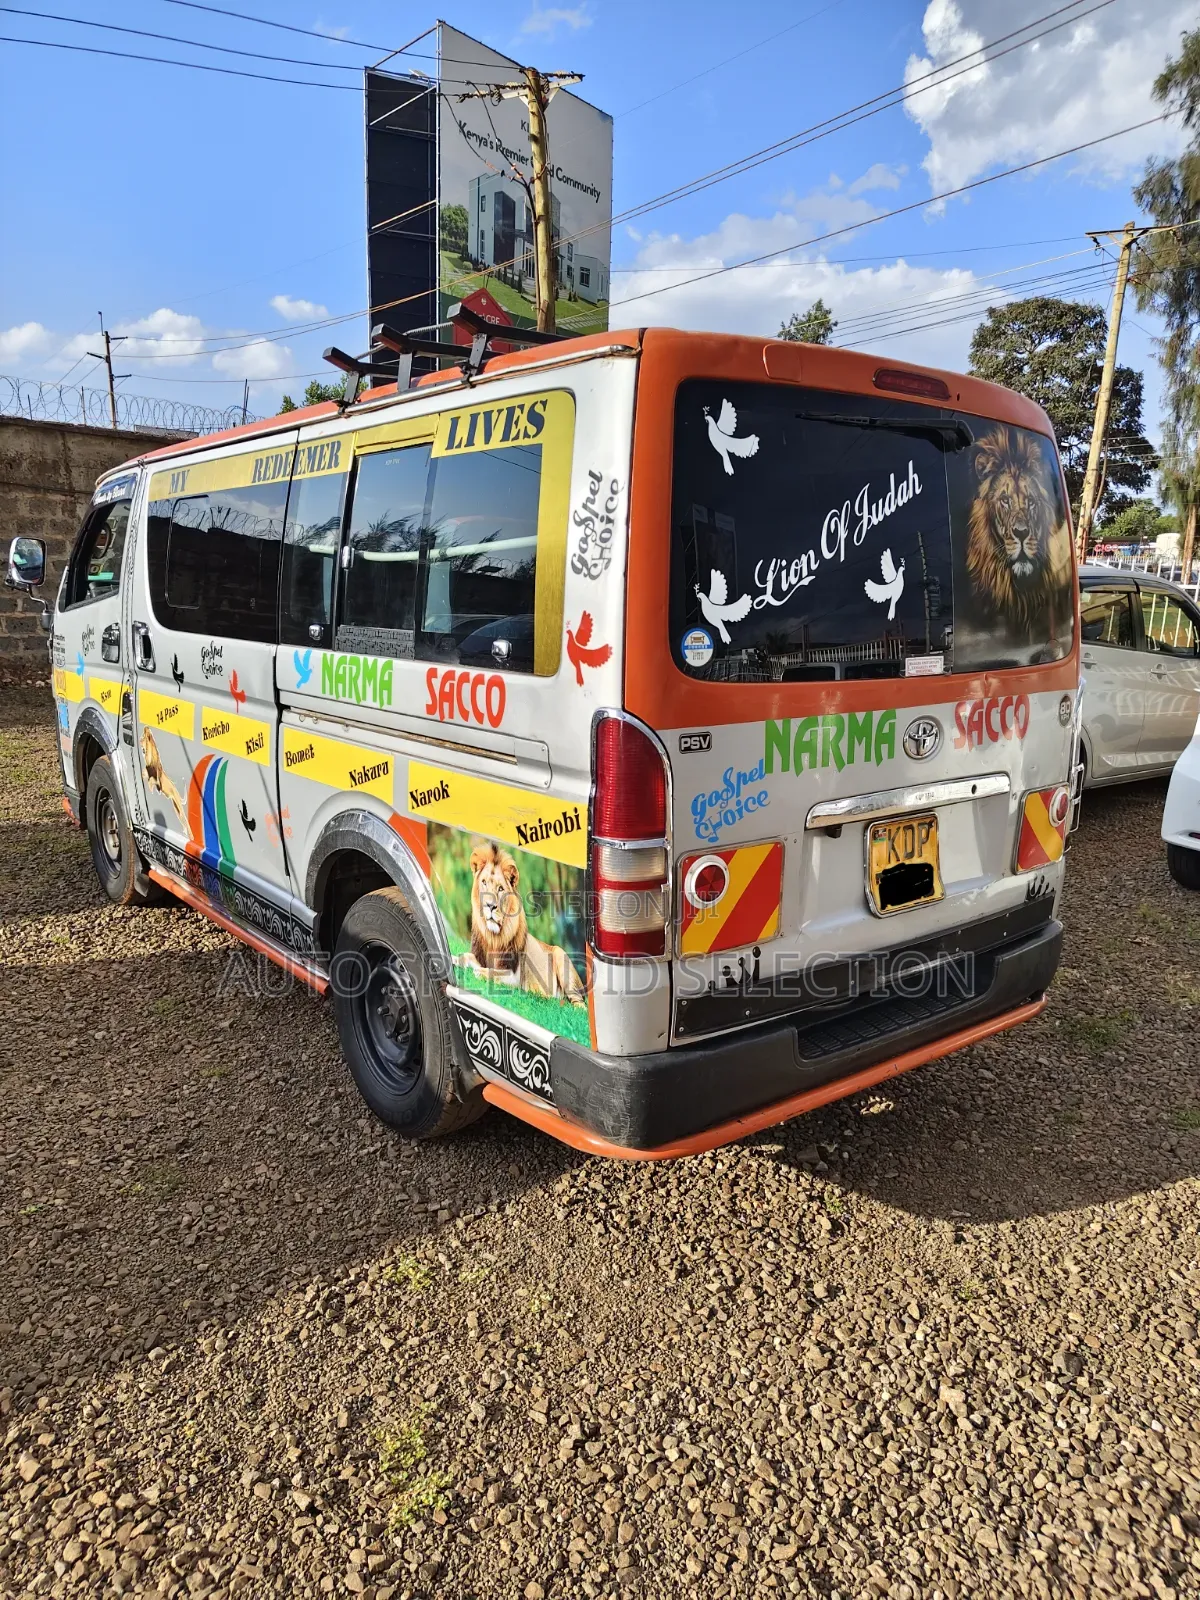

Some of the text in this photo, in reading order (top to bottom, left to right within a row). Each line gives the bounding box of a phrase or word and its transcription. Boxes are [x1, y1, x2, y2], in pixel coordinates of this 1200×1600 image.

[458, 120, 494, 150] Kenya's
[496, 138, 529, 166] Premier
[555, 166, 601, 203] Community
[445, 399, 548, 450] LIVES
[168, 440, 342, 494] MY REDEEMER
[753, 460, 922, 609] Lion Of Judah
[322, 653, 394, 709] NARMA
[426, 667, 506, 728] SACCO
[157, 705, 179, 725] 14 Pass
[954, 694, 1030, 752] SACCO
[1060, 700, 1070, 714] 80
[202, 721, 230, 741] Kericho
[245, 732, 264, 755] Kisii
[681, 736, 711, 751] PSV
[764, 708, 897, 777] NARMA
[285, 744, 315, 767] Bomet
[349, 761, 389, 788] Nakuru
[409, 780, 450, 809] Narok
[516, 807, 581, 846] Nairobi
[887, 822, 930, 862] KDP
